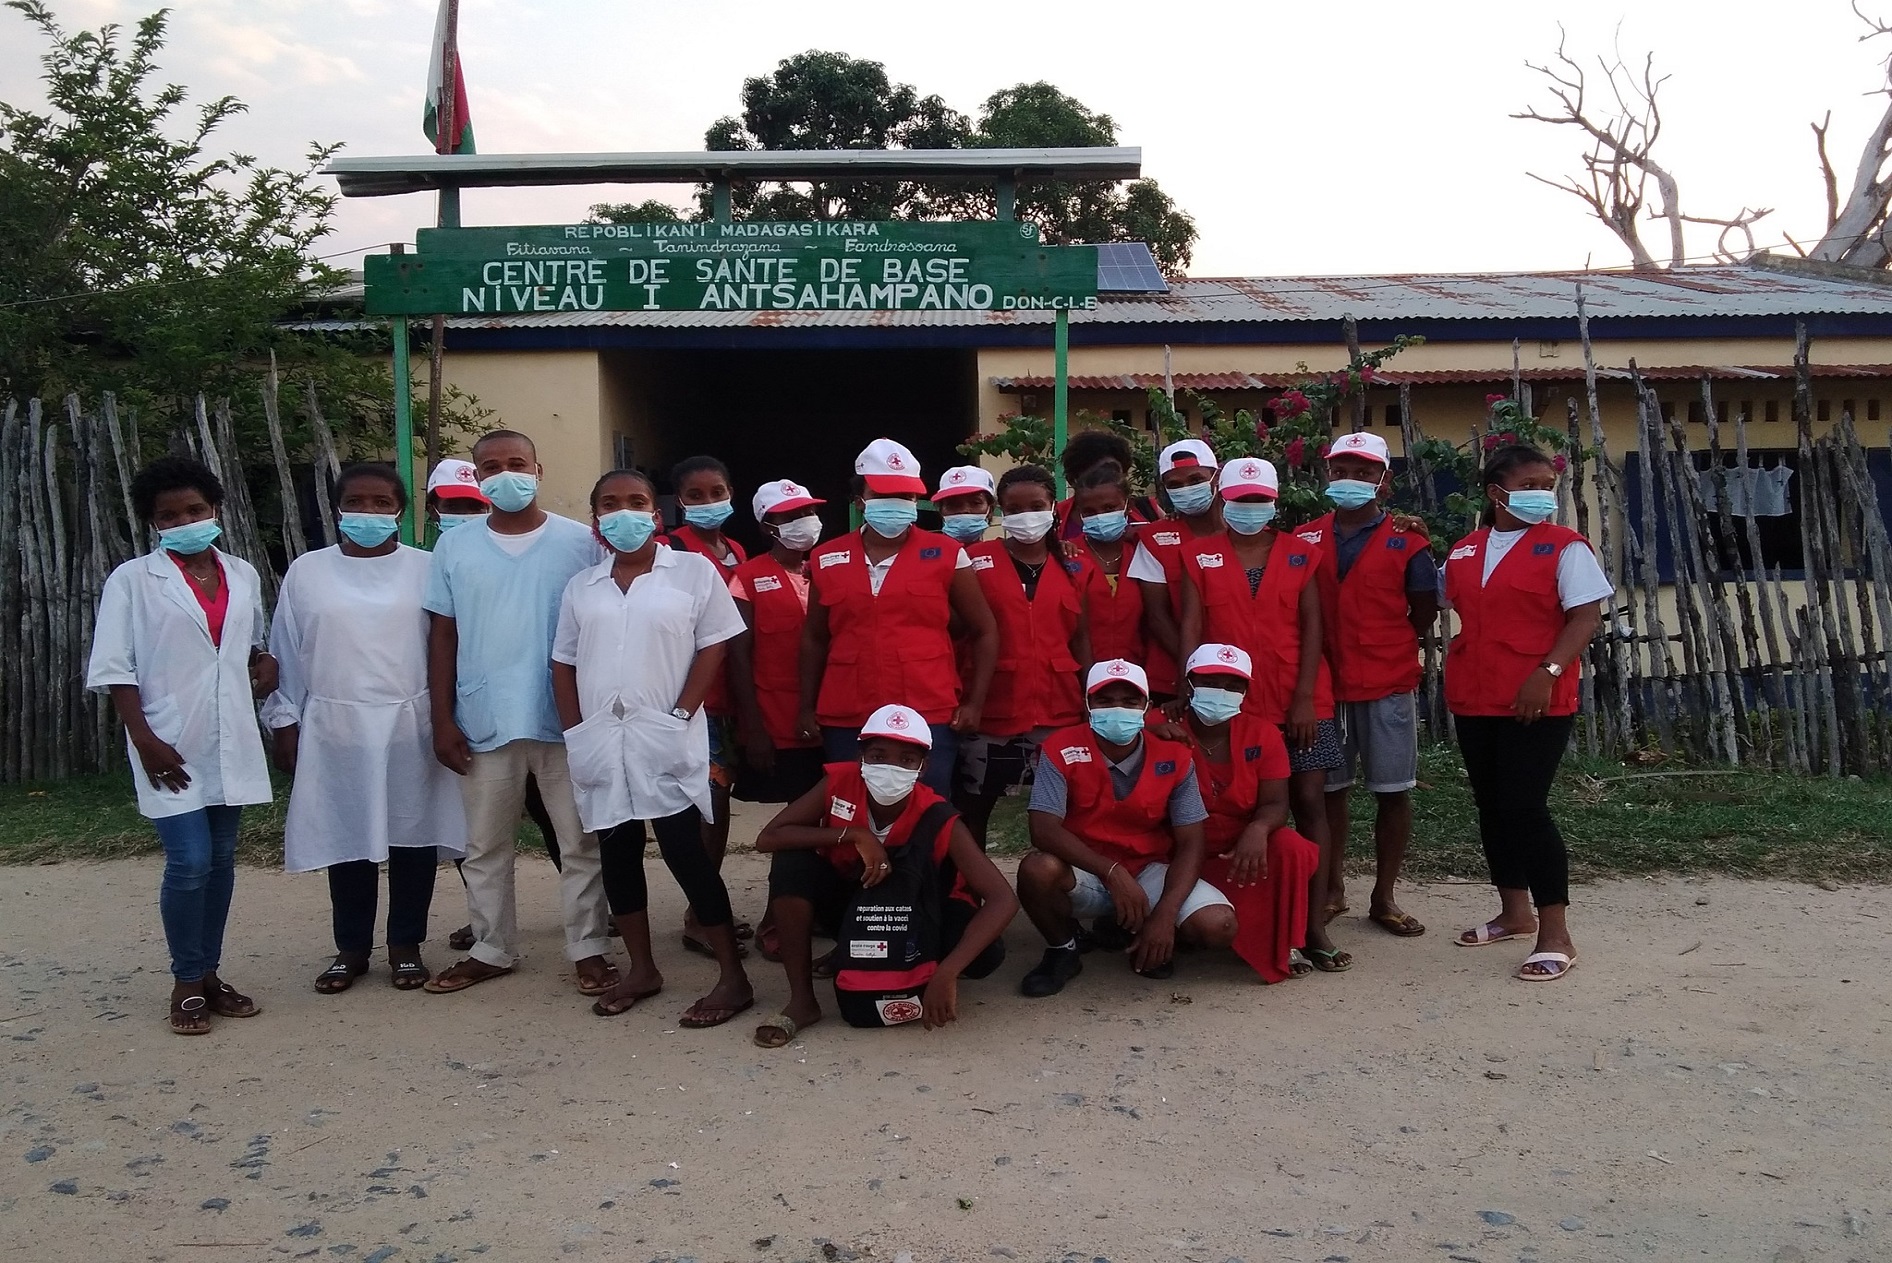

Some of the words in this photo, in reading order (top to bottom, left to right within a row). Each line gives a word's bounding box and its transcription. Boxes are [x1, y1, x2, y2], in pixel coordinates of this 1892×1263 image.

[506, 242, 593, 256] Fitiavana
[653, 239, 782, 261] Tanindrazana
[845, 239, 958, 253] Fandrosoana
[483, 260, 608, 286] CENTRE
[629, 259, 671, 284] DE
[696, 258, 799, 283] SANTE
[820, 258, 862, 283] DE
[883, 258, 970, 283] BASE
[643, 285, 661, 310] I
[699, 283, 994, 310] ANTSAHAMPANO
[862, 914, 883, 922] soutien
[887, 914, 893, 922] la
[891, 923, 908, 931] covid
